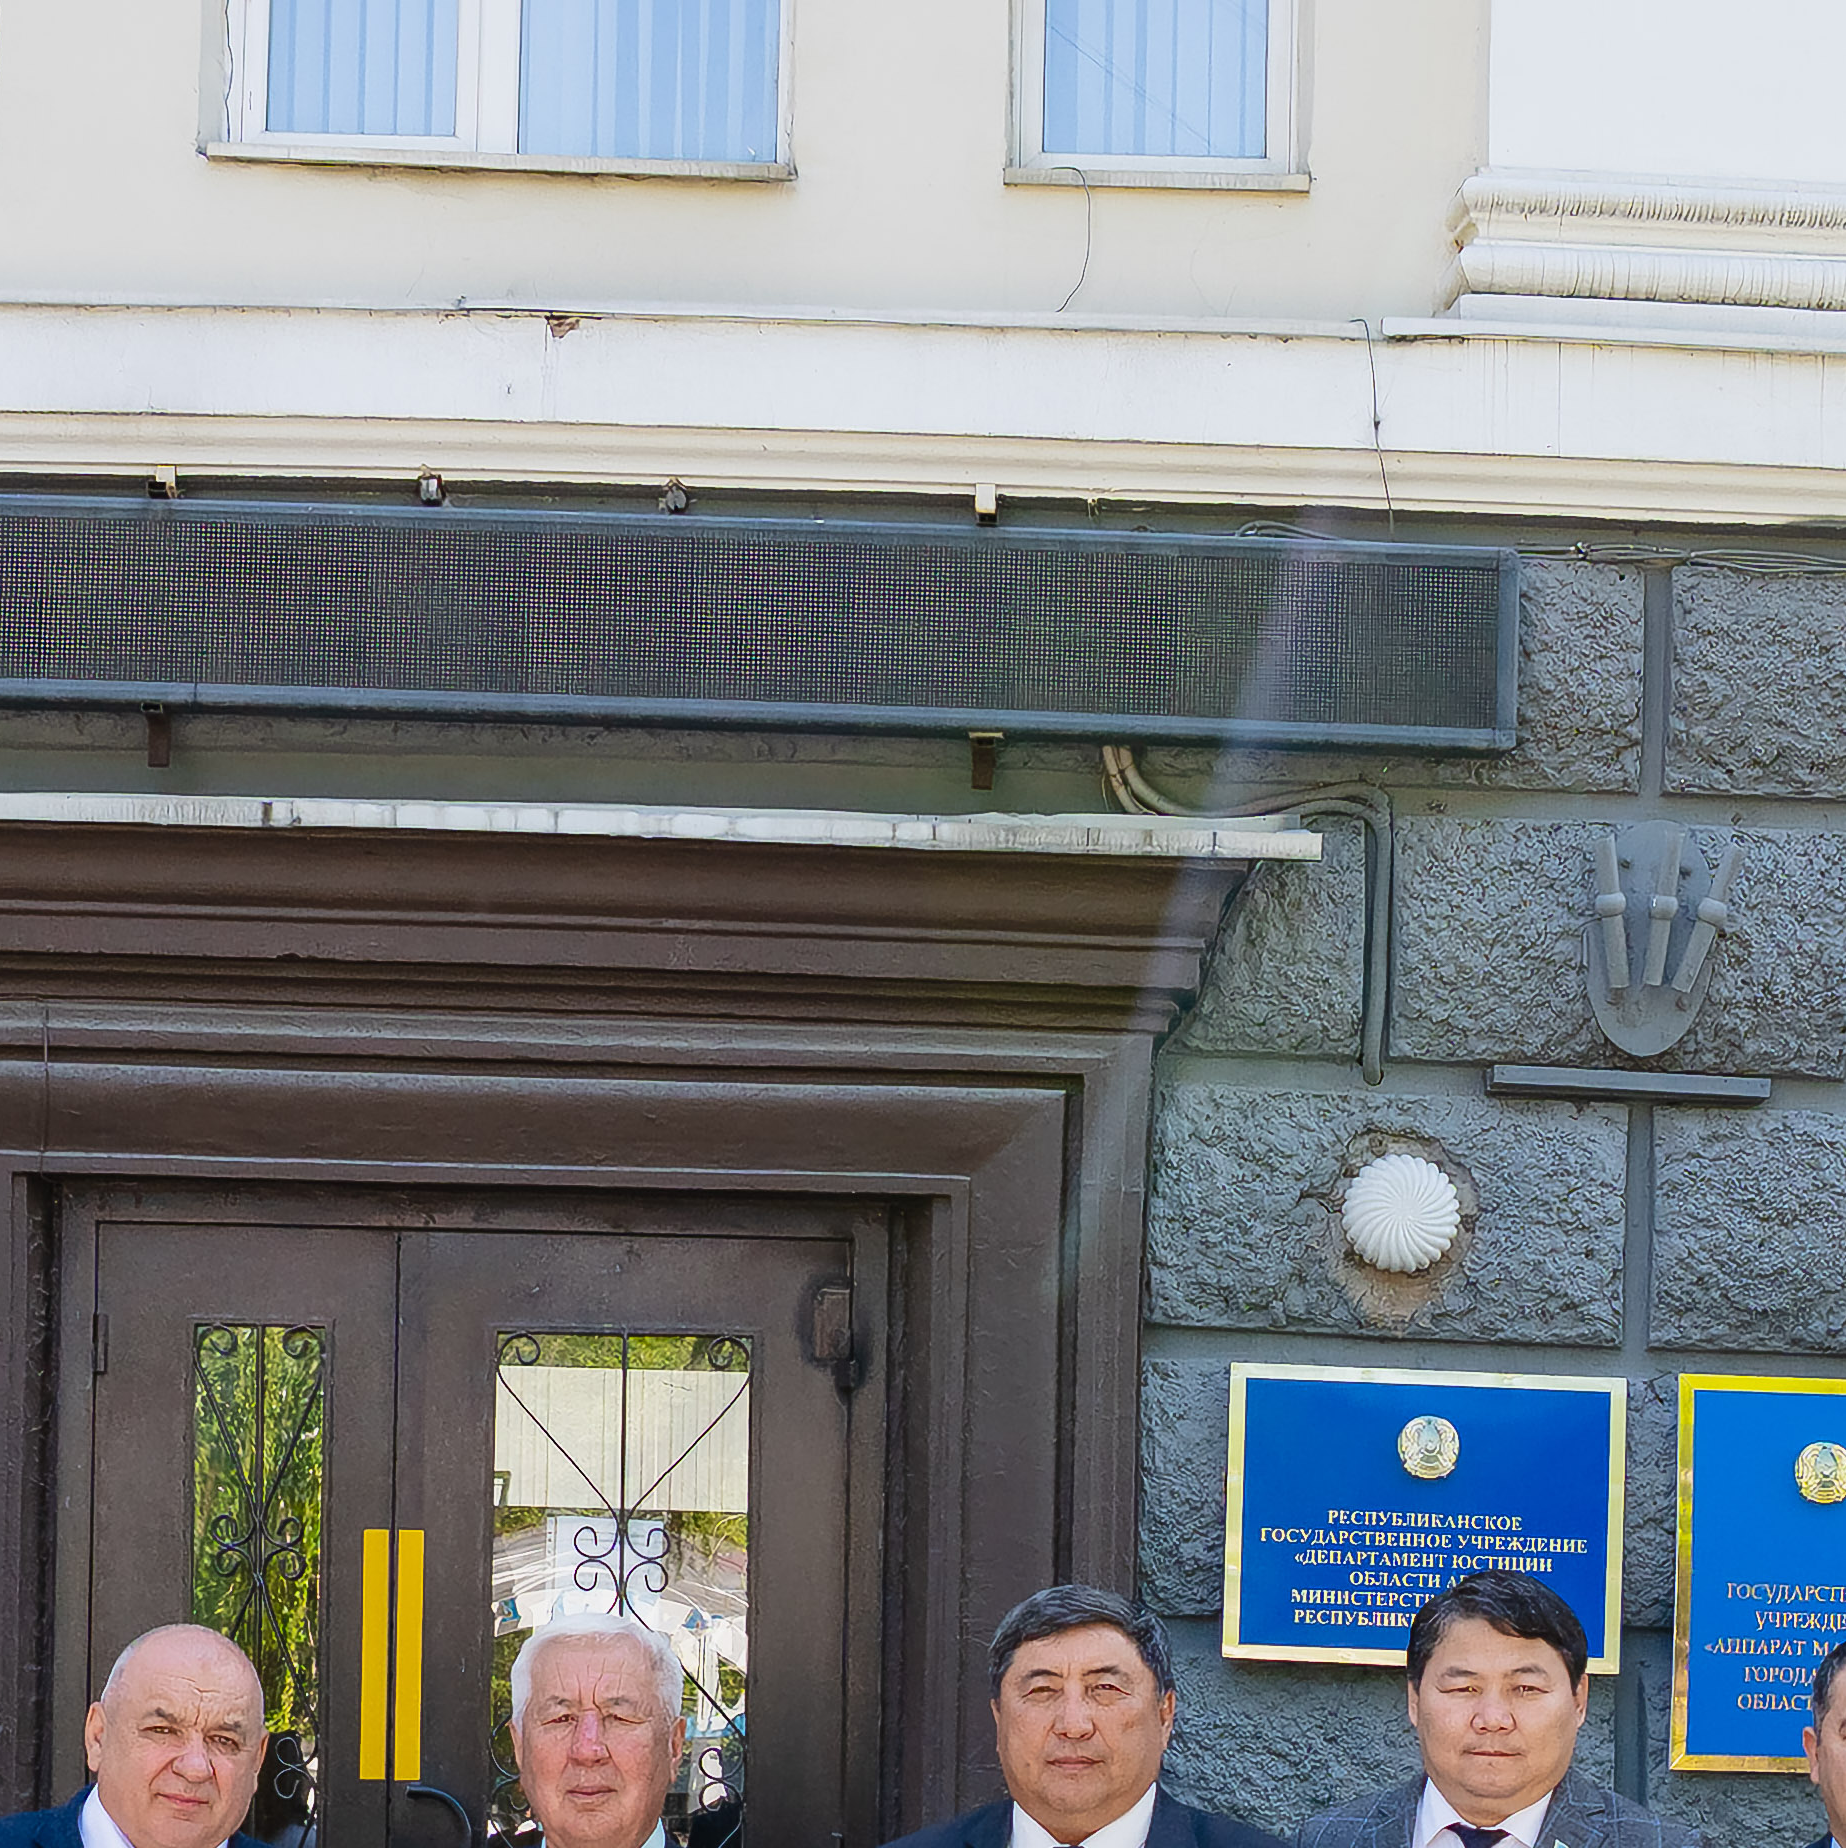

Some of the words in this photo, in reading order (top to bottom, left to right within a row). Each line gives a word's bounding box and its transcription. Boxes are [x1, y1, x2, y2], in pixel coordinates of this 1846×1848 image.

[1327, 1510, 1523, 1531] РЕСПУБЛИКАНСКОЕ
[1260, 1528, 1452, 1548] ГОСУДАРСТВЕННОЕ
[1457, 1535, 1588, 1554] УЧРЕЖДЕНИЕ
[1294, 1549, 1447, 1568] «ДЕПАРТАМЕНТ
[1452, 1554, 1553, 1573] ЮСТИЦИИ
[1349, 1571, 1441, 1588] ОБЛАСТИ
[1291, 1589, 1435, 1607] МИНИСТЕРСТ
